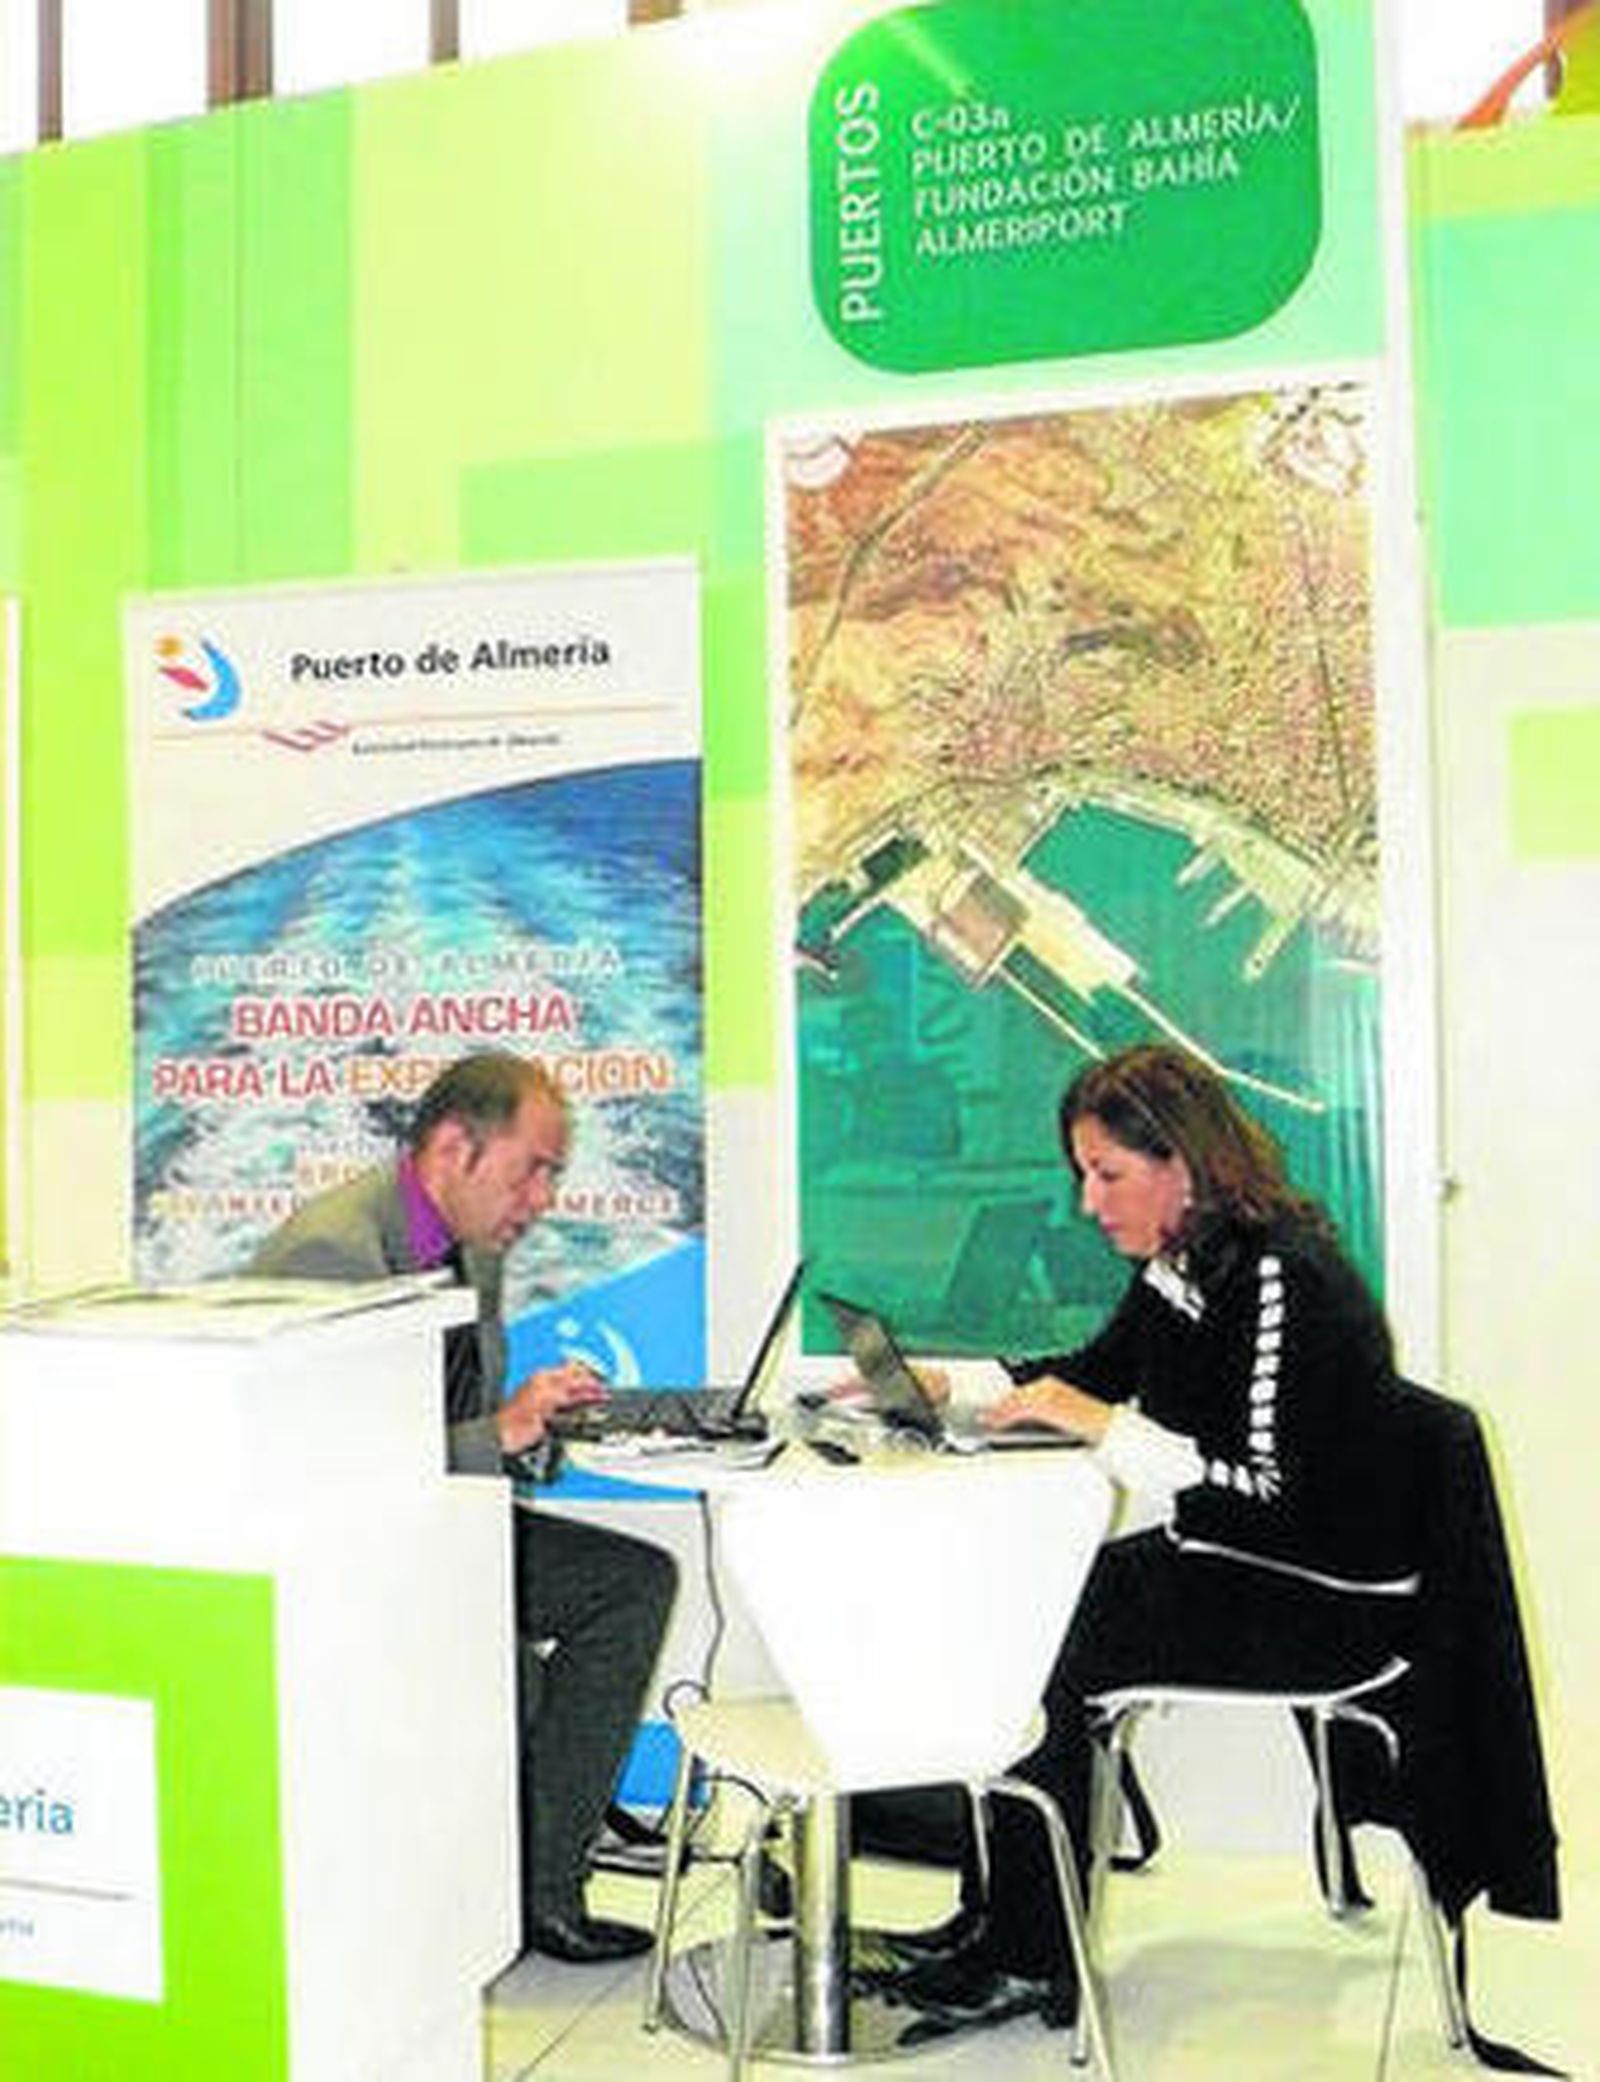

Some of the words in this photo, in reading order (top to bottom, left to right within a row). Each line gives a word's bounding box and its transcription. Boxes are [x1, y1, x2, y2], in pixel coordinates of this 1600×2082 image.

[913, 133, 1048, 178] PUERTO
[1064, 125, 1109, 157] DE
[1132, 143, 1241, 190] BAHÍA
[835, 82, 882, 323] PUERTOS
[915, 203, 1130, 255] ALMERIPORT
[290, 650, 407, 684] Puerto
[415, 643, 460, 675] de
[233, 998, 394, 1039] BANDA
[408, 995, 575, 1035] ANCHA
[152, 1060, 263, 1099] PARA
[279, 1057, 335, 1098] LA
